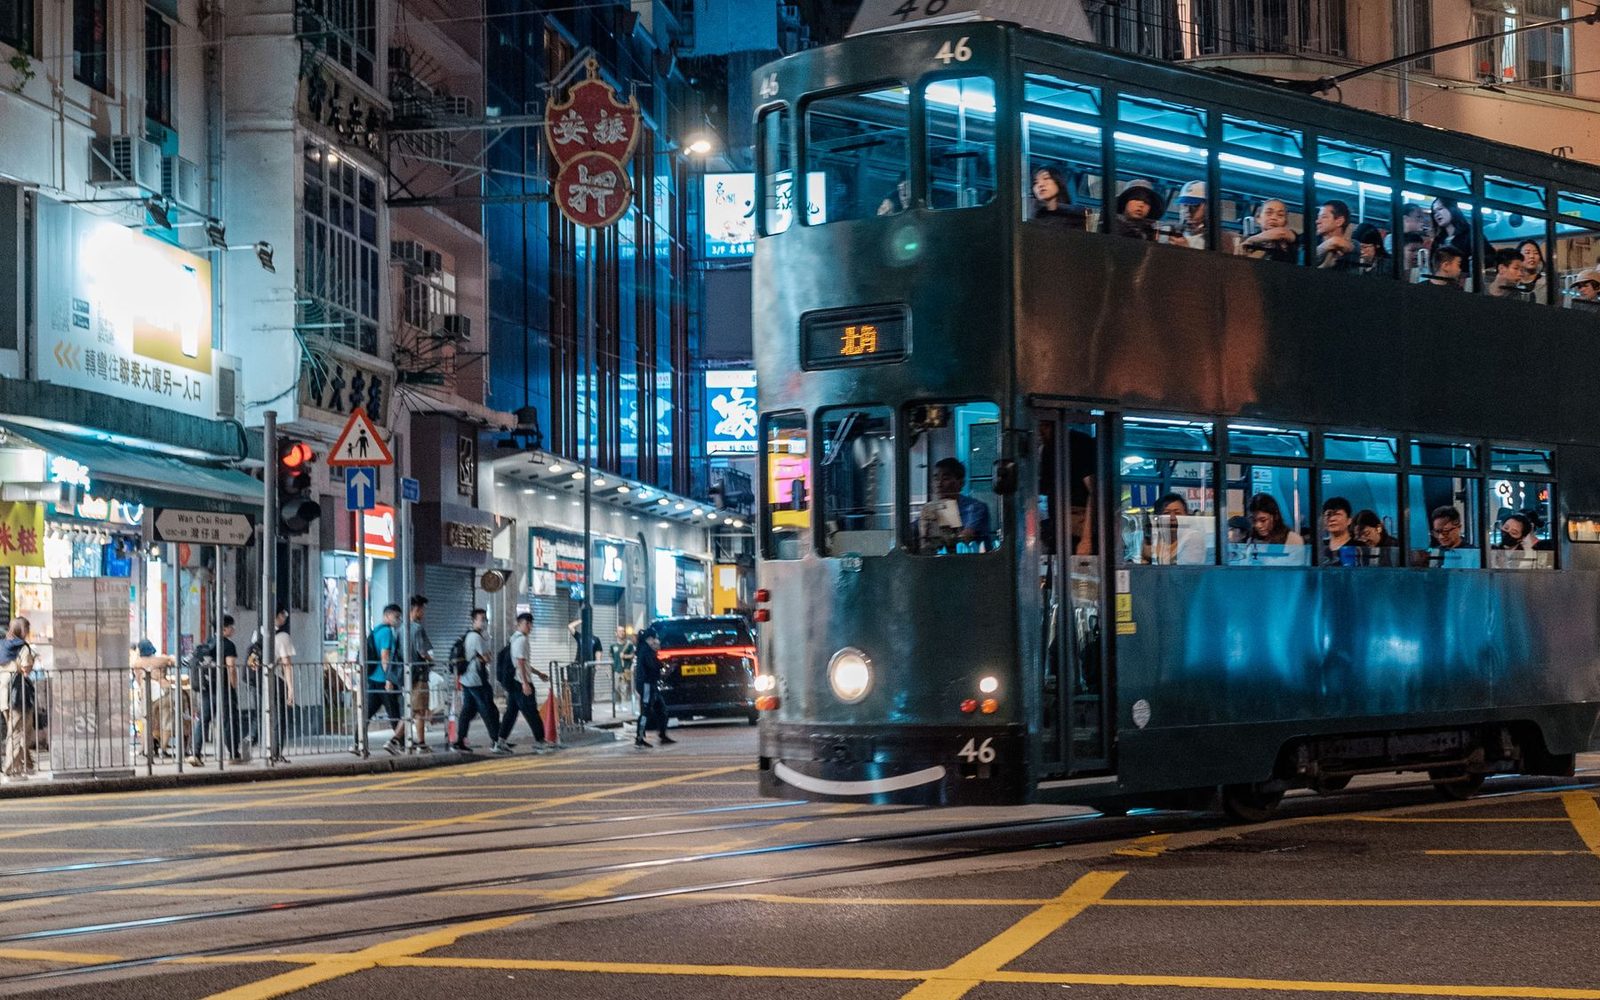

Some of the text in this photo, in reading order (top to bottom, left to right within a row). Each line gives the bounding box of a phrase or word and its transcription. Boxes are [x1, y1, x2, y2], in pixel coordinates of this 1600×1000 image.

[934, 36, 973, 64] 46
[759, 72, 780, 99] 46
[178, 513, 233, 526] Wan Chai Road
[190, 527, 220, 540] 灣仔道
[957, 736, 996, 764] 46
